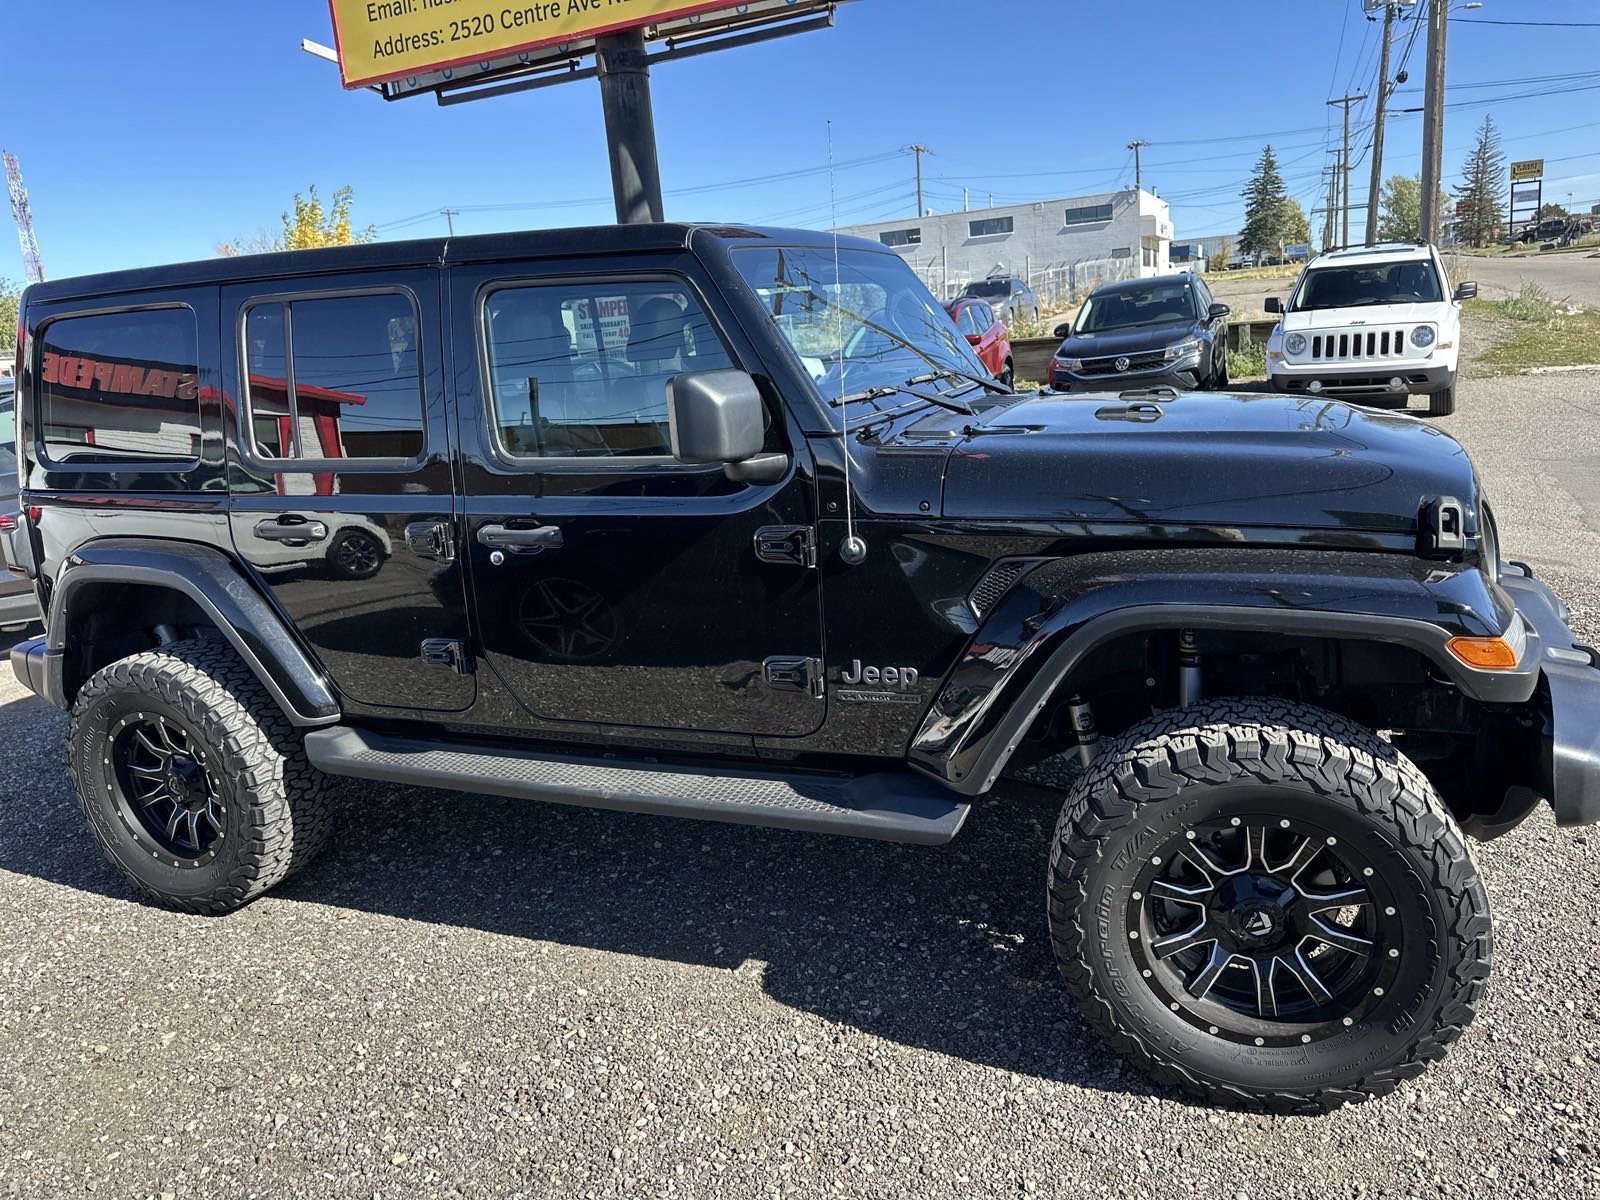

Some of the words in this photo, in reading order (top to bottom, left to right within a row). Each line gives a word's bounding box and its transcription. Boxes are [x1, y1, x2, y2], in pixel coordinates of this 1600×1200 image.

[367, 0, 417, 22] Email:
[373, 31, 444, 59] Address:
[449, 13, 495, 41] 2520
[500, 2, 561, 29] Centre
[567, 0, 600, 15] Ave
[841, 660, 919, 690] Jeep
